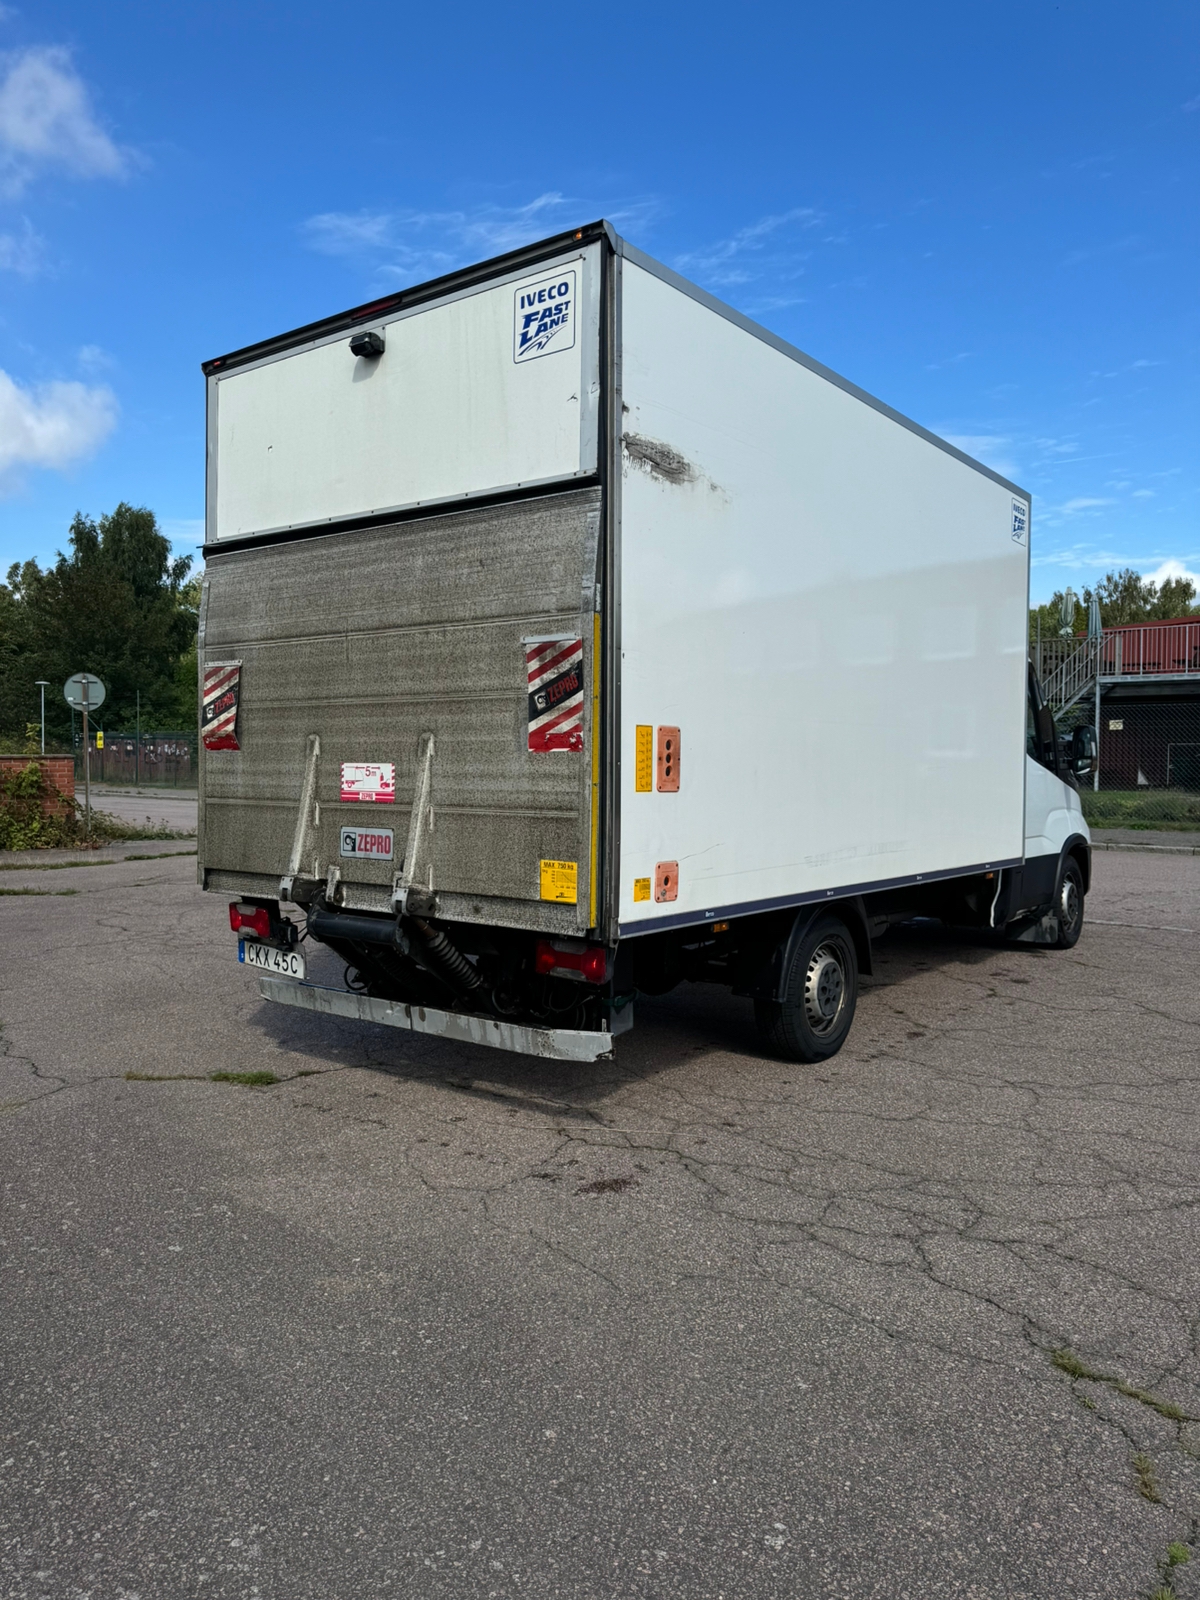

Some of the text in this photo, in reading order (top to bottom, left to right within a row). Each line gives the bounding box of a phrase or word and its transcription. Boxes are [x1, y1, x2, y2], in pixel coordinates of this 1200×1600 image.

[520, 281, 569, 309] IVECO
[521, 300, 571, 331] FAST
[519, 313, 569, 349] LANE
[547, 673, 579, 702] ZEPRO
[365, 765, 371, 777] 5
[361, 792, 374, 801] ZEPRO
[357, 833, 392, 855] ZEPRO
[248, 944, 298, 974] CKX 45C
